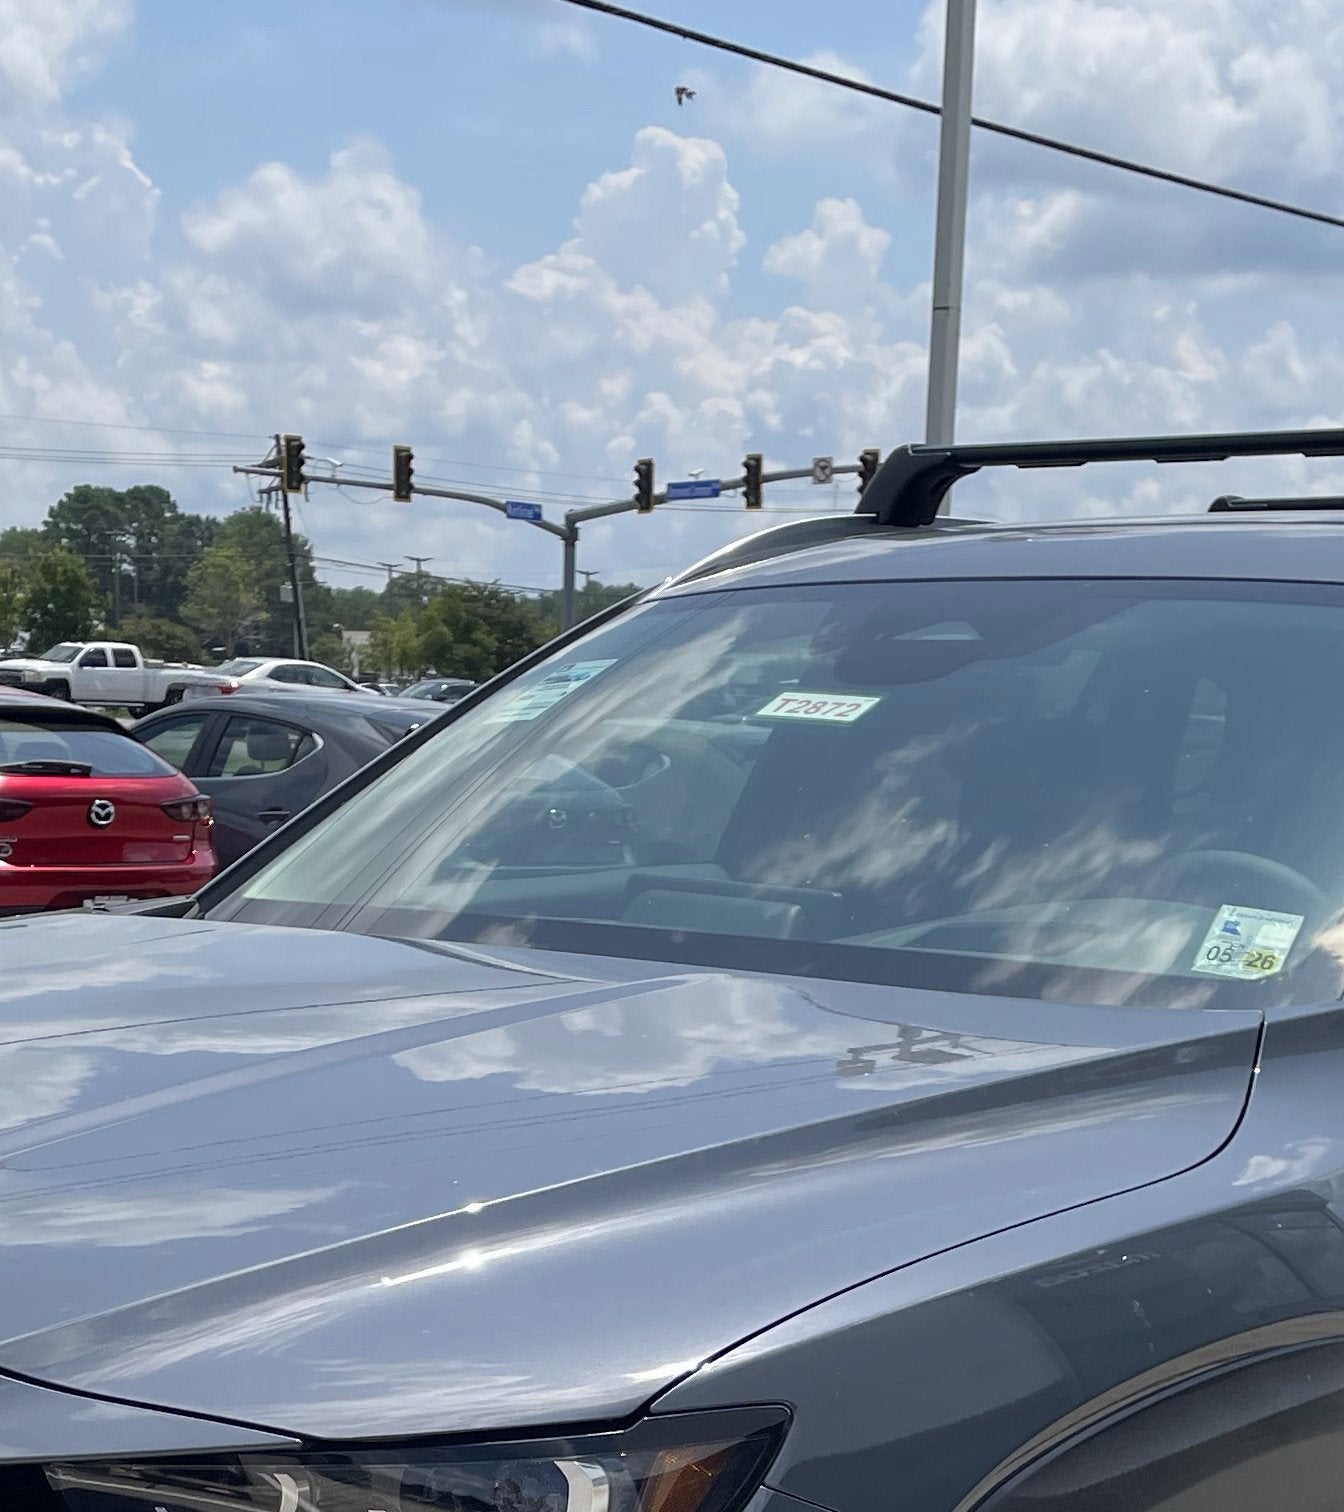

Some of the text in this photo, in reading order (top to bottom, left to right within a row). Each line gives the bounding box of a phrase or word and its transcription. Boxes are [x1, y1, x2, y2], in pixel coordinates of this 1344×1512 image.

[773, 698, 861, 717] T2872
[1206, 945, 1276, 970] 05 26
